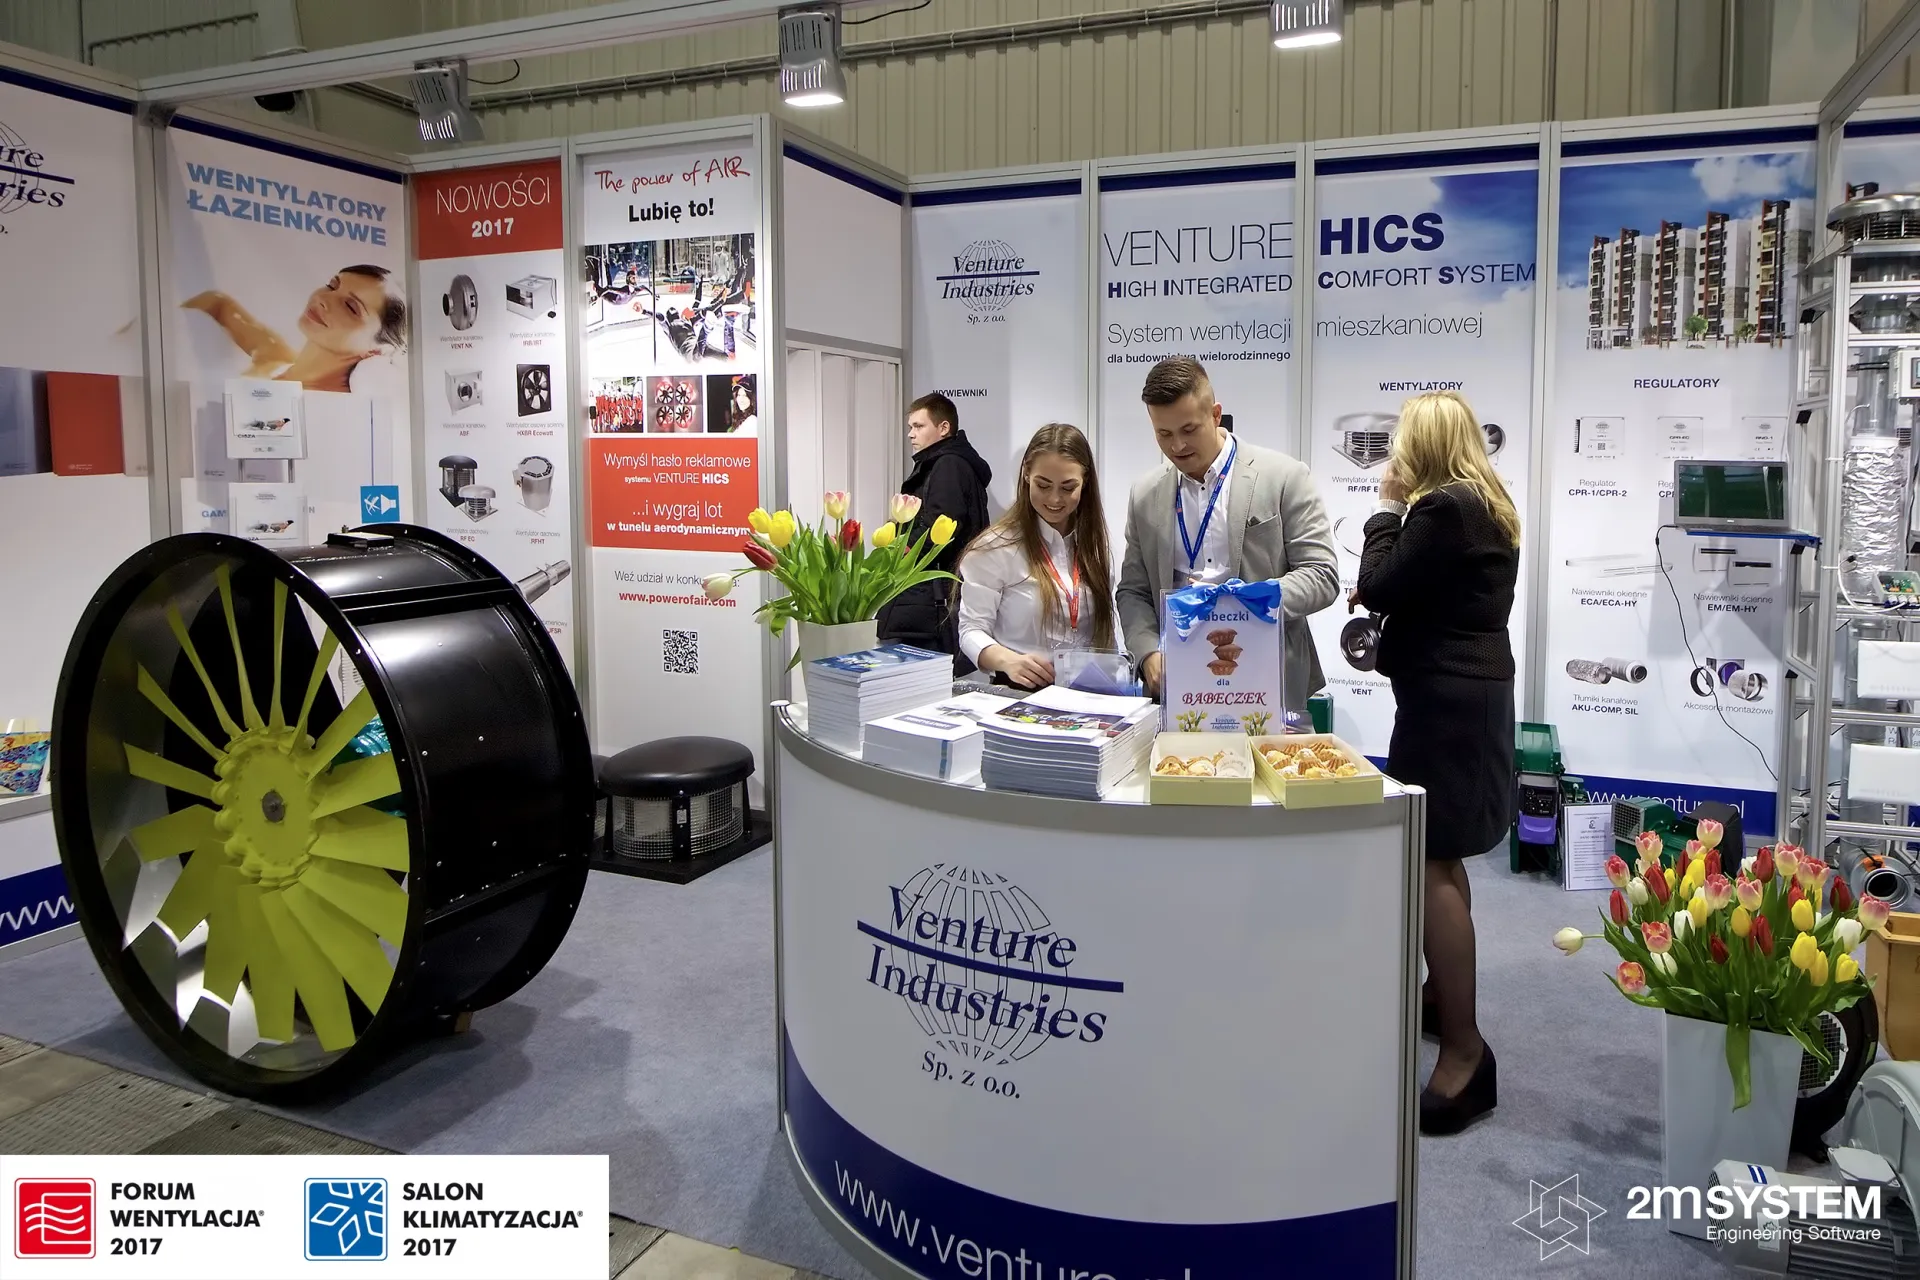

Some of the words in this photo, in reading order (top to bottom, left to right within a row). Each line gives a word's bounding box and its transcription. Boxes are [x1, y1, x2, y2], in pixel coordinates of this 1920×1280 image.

[595, 170, 625, 192] The
[632, 173, 674, 194] power
[682, 160, 702, 186] of
[704, 156, 751, 183] AIR
[186, 161, 386, 222] WENTYLATORY
[436, 172, 551, 215] NOWOŚCI
[186, 189, 387, 246] ŁAZIENKOWE
[628, 201, 682, 223] Lubię
[688, 198, 714, 217] to!
[472, 217, 515, 238] 2017
[1320, 212, 1445, 256] HICS
[1103, 222, 1294, 267] VENTURE
[953, 256, 1025, 273] Venture
[1317, 267, 1432, 289] COMFORT
[1438, 263, 1536, 285] SYSTEM
[942, 280, 1035, 299] Industries
[1108, 281, 1156, 298] HIGH
[1163, 274, 1293, 297] INTEGRATED
[1316, 312, 1483, 338] mieszkaniowej
[1107, 322, 1183, 348] System
[1190, 318, 1292, 345] wentylacji
[1107, 353, 1123, 363] dla
[1200, 350, 1291, 362] wielorodzinnego
[1379, 381, 1464, 391] WENTYLATORY
[1634, 378, 1720, 389] REGULATORY
[604, 453, 648, 469] Wymyśl
[651, 452, 682, 468] hasło
[685, 453, 751, 468] reklamowe
[624, 475, 651, 484] systemu
[653, 472, 700, 484] VENTURE
[702, 473, 730, 485] HICS
[1331, 476, 1368, 484] Wentylator
[1579, 479, 1616, 488] Regulator
[1347, 485, 1371, 493] RF/RF
[1568, 488, 1627, 497] CPR-1/CPR-2
[652, 501, 700, 521] wygraj
[704, 501, 723, 518] lot
[607, 522, 615, 531] w
[618, 522, 651, 532] tunelu
[654, 523, 751, 537] aerodynamicznym
[614, 570, 634, 582] Weź
[637, 572, 663, 584] udział
[665, 575, 674, 583] w
[1571, 587, 1615, 597] Nawiewniki
[1616, 588, 1648, 598] okienne
[1693, 593, 1739, 603] Nawiewniki
[1741, 594, 1773, 604] ścienne
[1580, 598, 1638, 608] ECA/ECA-HY
[1707, 603, 1758, 613] EM/EM-HY
[1204, 611, 1249, 622] abeczki
[1327, 677, 1364, 686] Wentylator
[1182, 692, 1267, 706] BABECZEK
[1351, 688, 1372, 696] VENT
[1573, 694, 1600, 703] Tłumiki
[1601, 695, 1638, 706] kanałowe
[1624, 707, 1639, 716] SIL
[1725, 703, 1774, 716] montażowe
[888, 885, 1077, 968] Venture
[866, 943, 1107, 1043] Industries
[921, 1050, 953, 1081] Sp.
[961, 1069, 975, 1087] z
[983, 1076, 1021, 1099] o.o.
